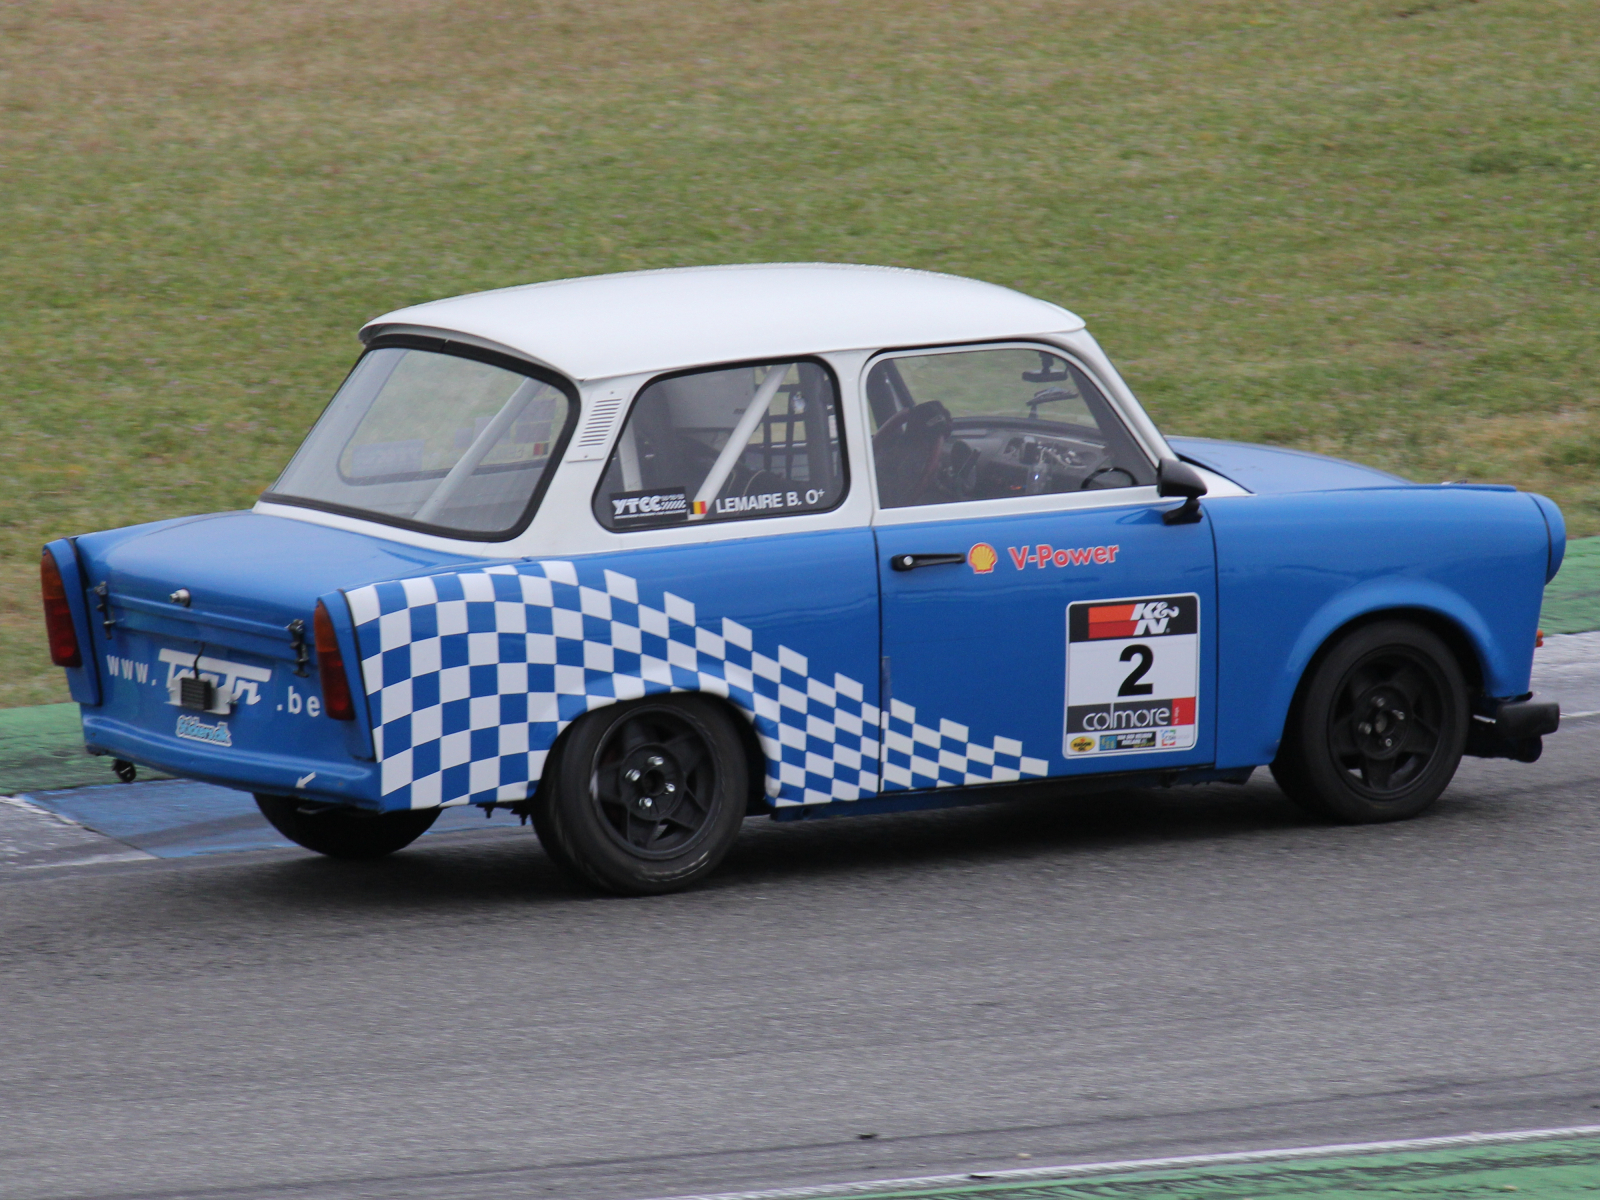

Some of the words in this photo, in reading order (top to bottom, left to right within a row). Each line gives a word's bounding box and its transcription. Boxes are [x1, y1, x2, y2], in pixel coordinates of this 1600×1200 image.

[611, 494, 661, 515] YTCC
[715, 492, 784, 513] LEMAIRE
[787, 491, 803, 507] B.
[1007, 543, 1120, 571] V-Power
[1117, 643, 1154, 697] 2
[1082, 702, 1171, 731] colmore
